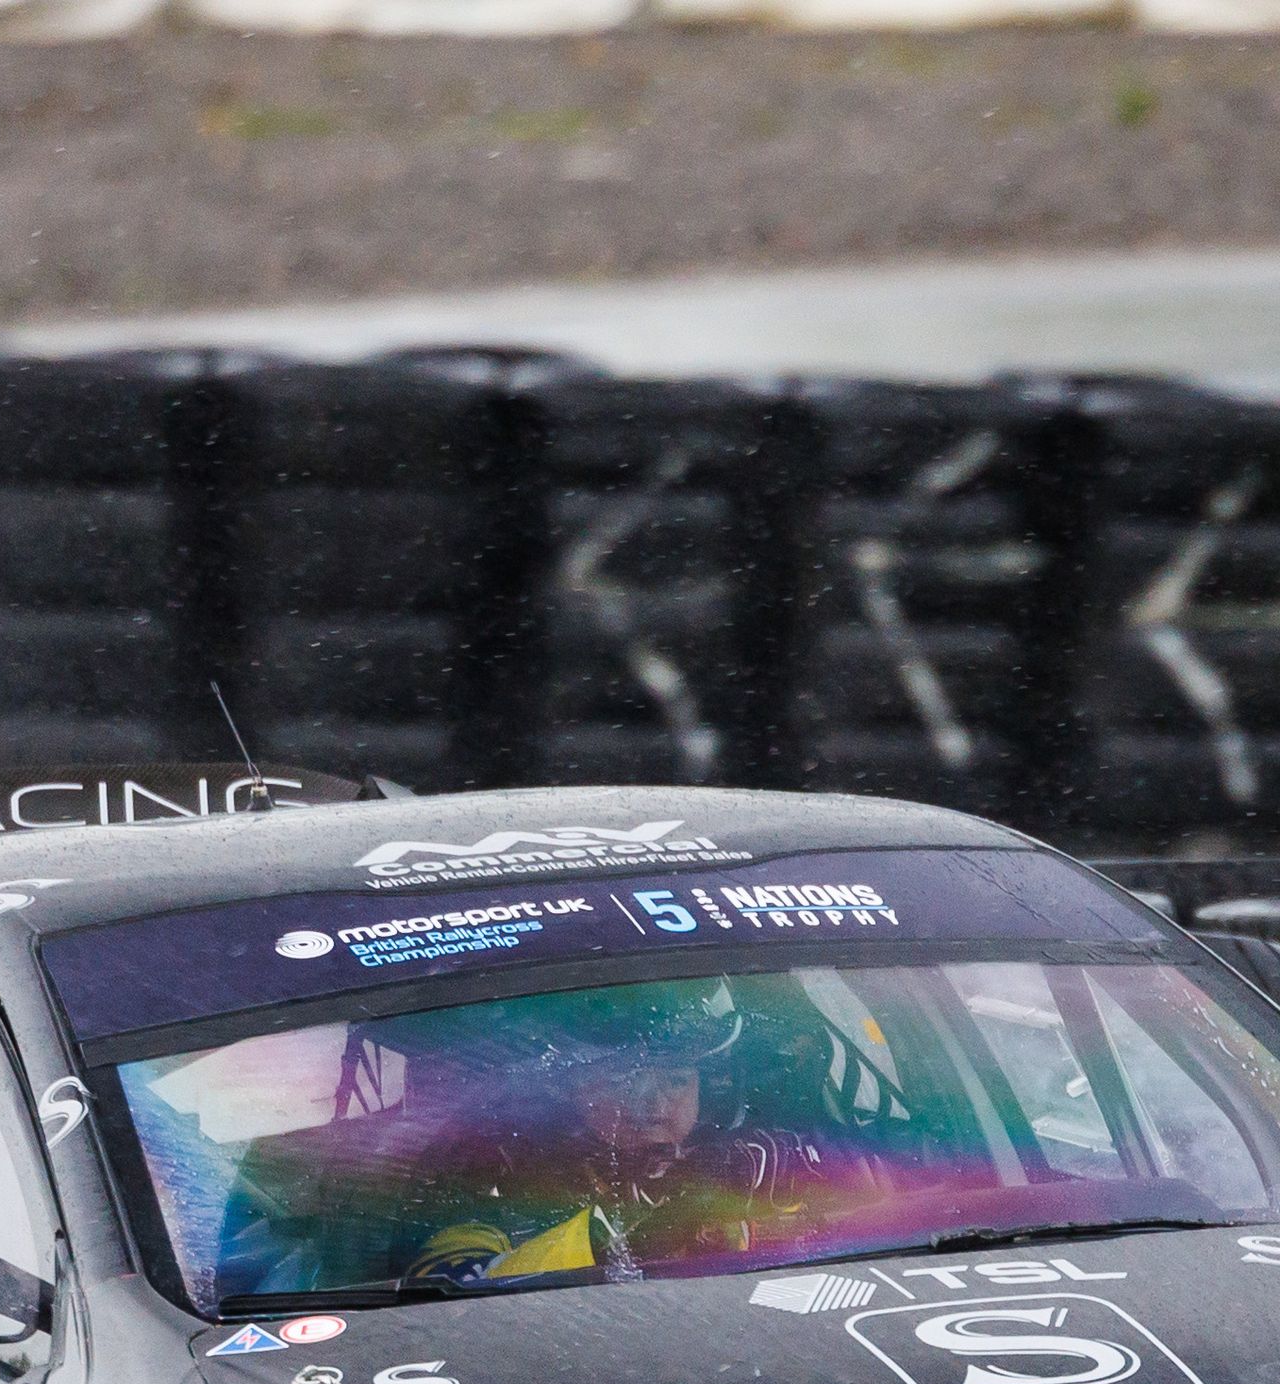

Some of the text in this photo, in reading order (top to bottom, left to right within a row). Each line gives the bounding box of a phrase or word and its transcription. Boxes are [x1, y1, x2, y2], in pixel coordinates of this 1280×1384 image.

[365, 873, 438, 889] Vehicle
[337, 901, 543, 944] motorsport
[632, 890, 697, 932] 5
[720, 885, 884, 909] NATIONS
[348, 919, 543, 957] British Rallycross
[358, 935, 520, 967] Championship
[903, 1258, 1128, 1289] TSL
